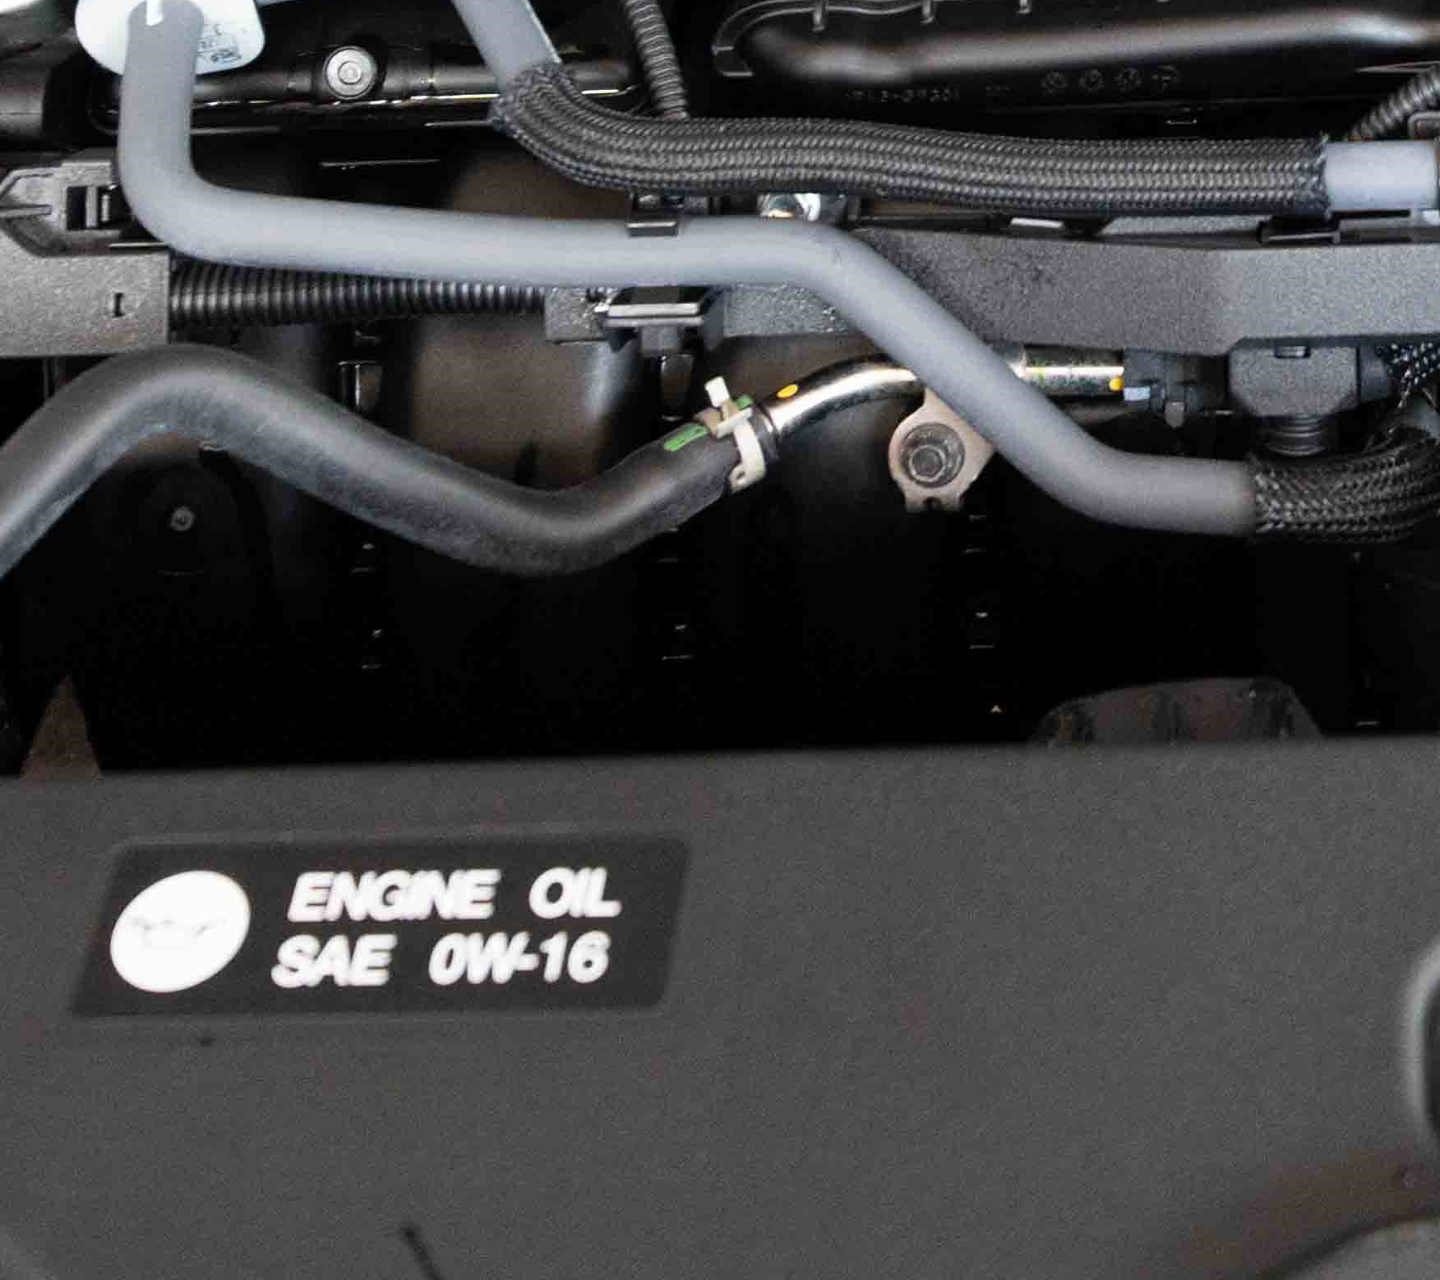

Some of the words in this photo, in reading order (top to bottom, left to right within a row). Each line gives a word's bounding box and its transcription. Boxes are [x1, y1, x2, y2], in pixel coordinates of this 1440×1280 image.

[288, 869, 500, 922] ENGINE
[529, 868, 621, 918] OIL
[271, 934, 396, 988] SAE
[429, 931, 610, 985] 0W-16
